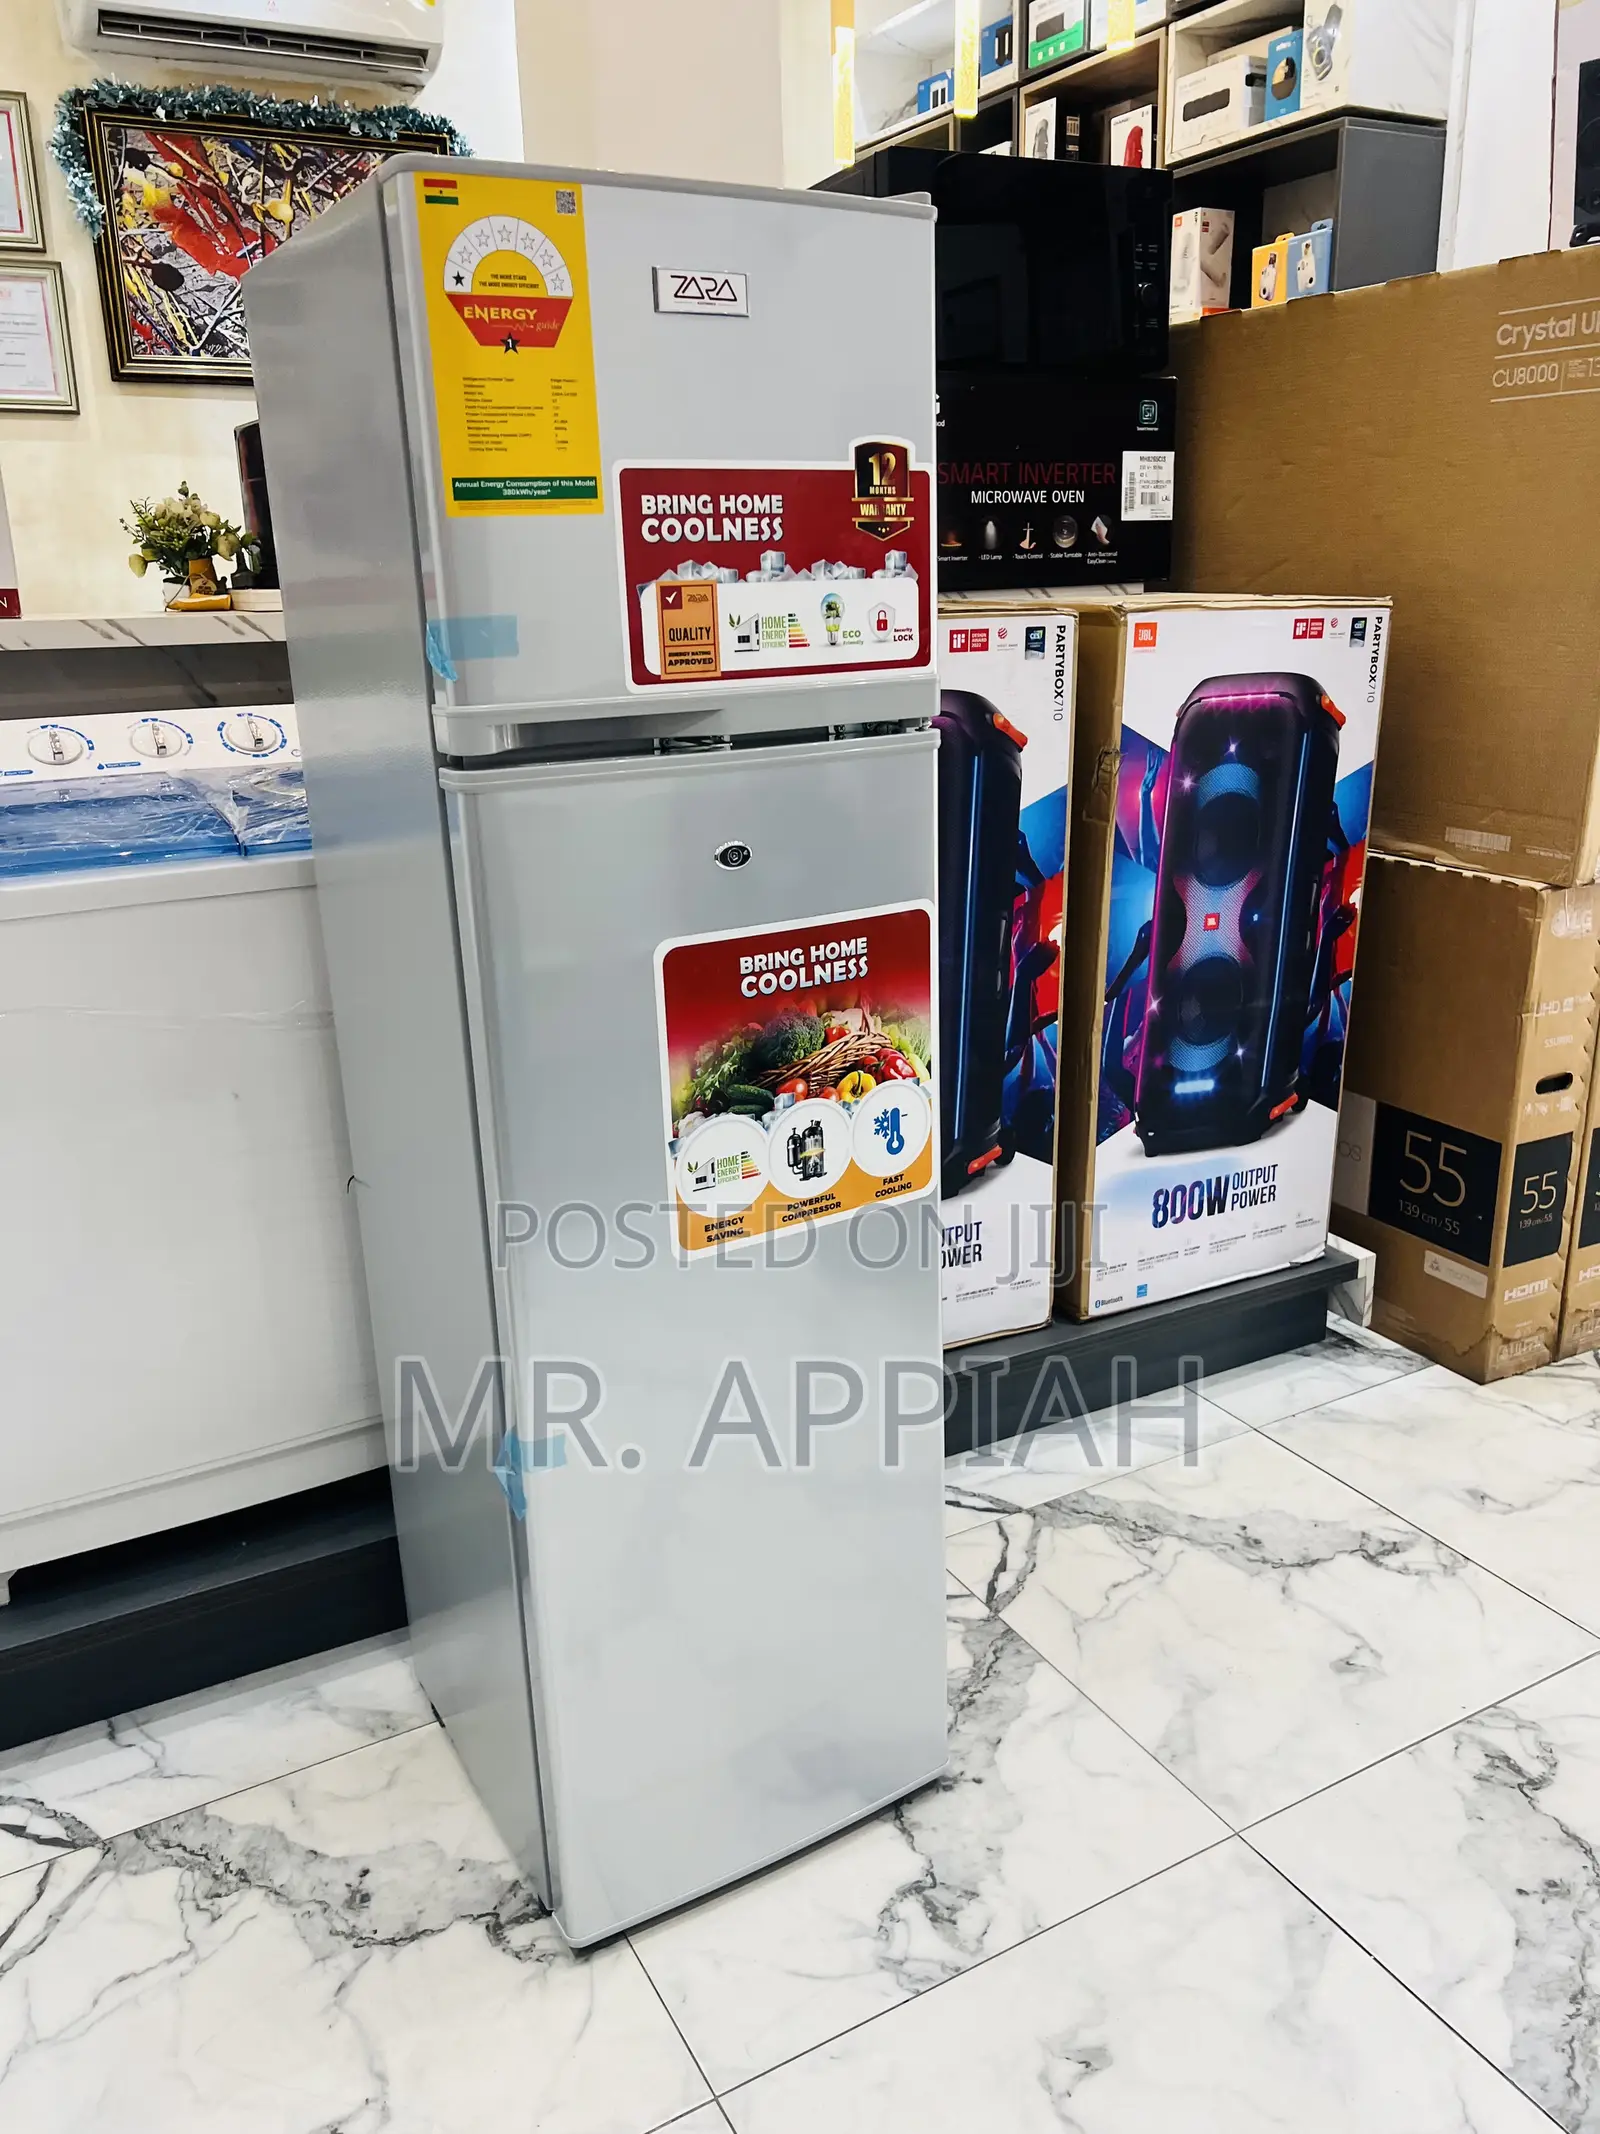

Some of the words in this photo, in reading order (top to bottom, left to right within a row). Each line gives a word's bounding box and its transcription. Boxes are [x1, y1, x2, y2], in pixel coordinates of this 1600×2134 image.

[670, 275, 737, 302] ZARA
[463, 304, 537, 324] ENERGY
[536, 319, 560, 332] guide
[1496, 313, 1577, 351] Crystal
[1581, 310, 1600, 335] U
[507, 338, 513, 348] 1
[1492, 363, 1559, 388] CU8000
[868, 452, 897, 486] 12
[938, 462, 1011, 486] SMART
[1018, 462, 1116, 485] INVERTER
[480, 481, 504, 489] Energy
[506, 480, 551, 489] Consumption
[869, 486, 896, 495] MONTHS
[641, 494, 713, 515] BRING
[719, 494, 783, 514] HOME
[971, 490, 1047, 504] MICROWAVE
[1052, 490, 1085, 503] OVEN
[860, 503, 906, 516] WARANTY
[641, 517, 783, 543] COOLNESS
[761, 616, 787, 629] HOME
[668, 626, 711, 642] QUALITY
[761, 630, 787, 640] ENERGY
[842, 630, 861, 638] ECO
[893, 634, 914, 642] LOCK
[1138, 629, 1153, 641] JBL
[761, 641, 787, 649] EFFICIENCY
[668, 658, 714, 667] APPROVED
[739, 948, 804, 975] BRING
[809, 937, 868, 961] HOME
[741, 956, 868, 998] COOLNESS
[717, 1155, 740, 1169] HOME
[1400, 1130, 1468, 1208] 55
[717, 1166, 740, 1177] ENERGY
[882, 1174, 905, 1186] FAST
[1232, 1163, 1279, 1191] OUTPUT
[875, 1182, 912, 1198] COOLING
[1231, 1184, 1277, 1212] POWER
[1520, 1171, 1558, 1215] 55
[787, 1193, 836, 1212] POWERFUL
[1151, 1175, 1230, 1229] 800W
[1399, 1200, 1420, 1218] 139
[782, 1202, 842, 1223] COMPRESSOR
[704, 1216, 745, 1233] ENERGY
[706, 1227, 744, 1243] SAVING
[941, 1221, 983, 1248] TPUT
[941, 1243, 982, 1269] WER
[1504, 1279, 1549, 1300] HDMI
[1101, 1295, 1123, 1307] Bluetooth
